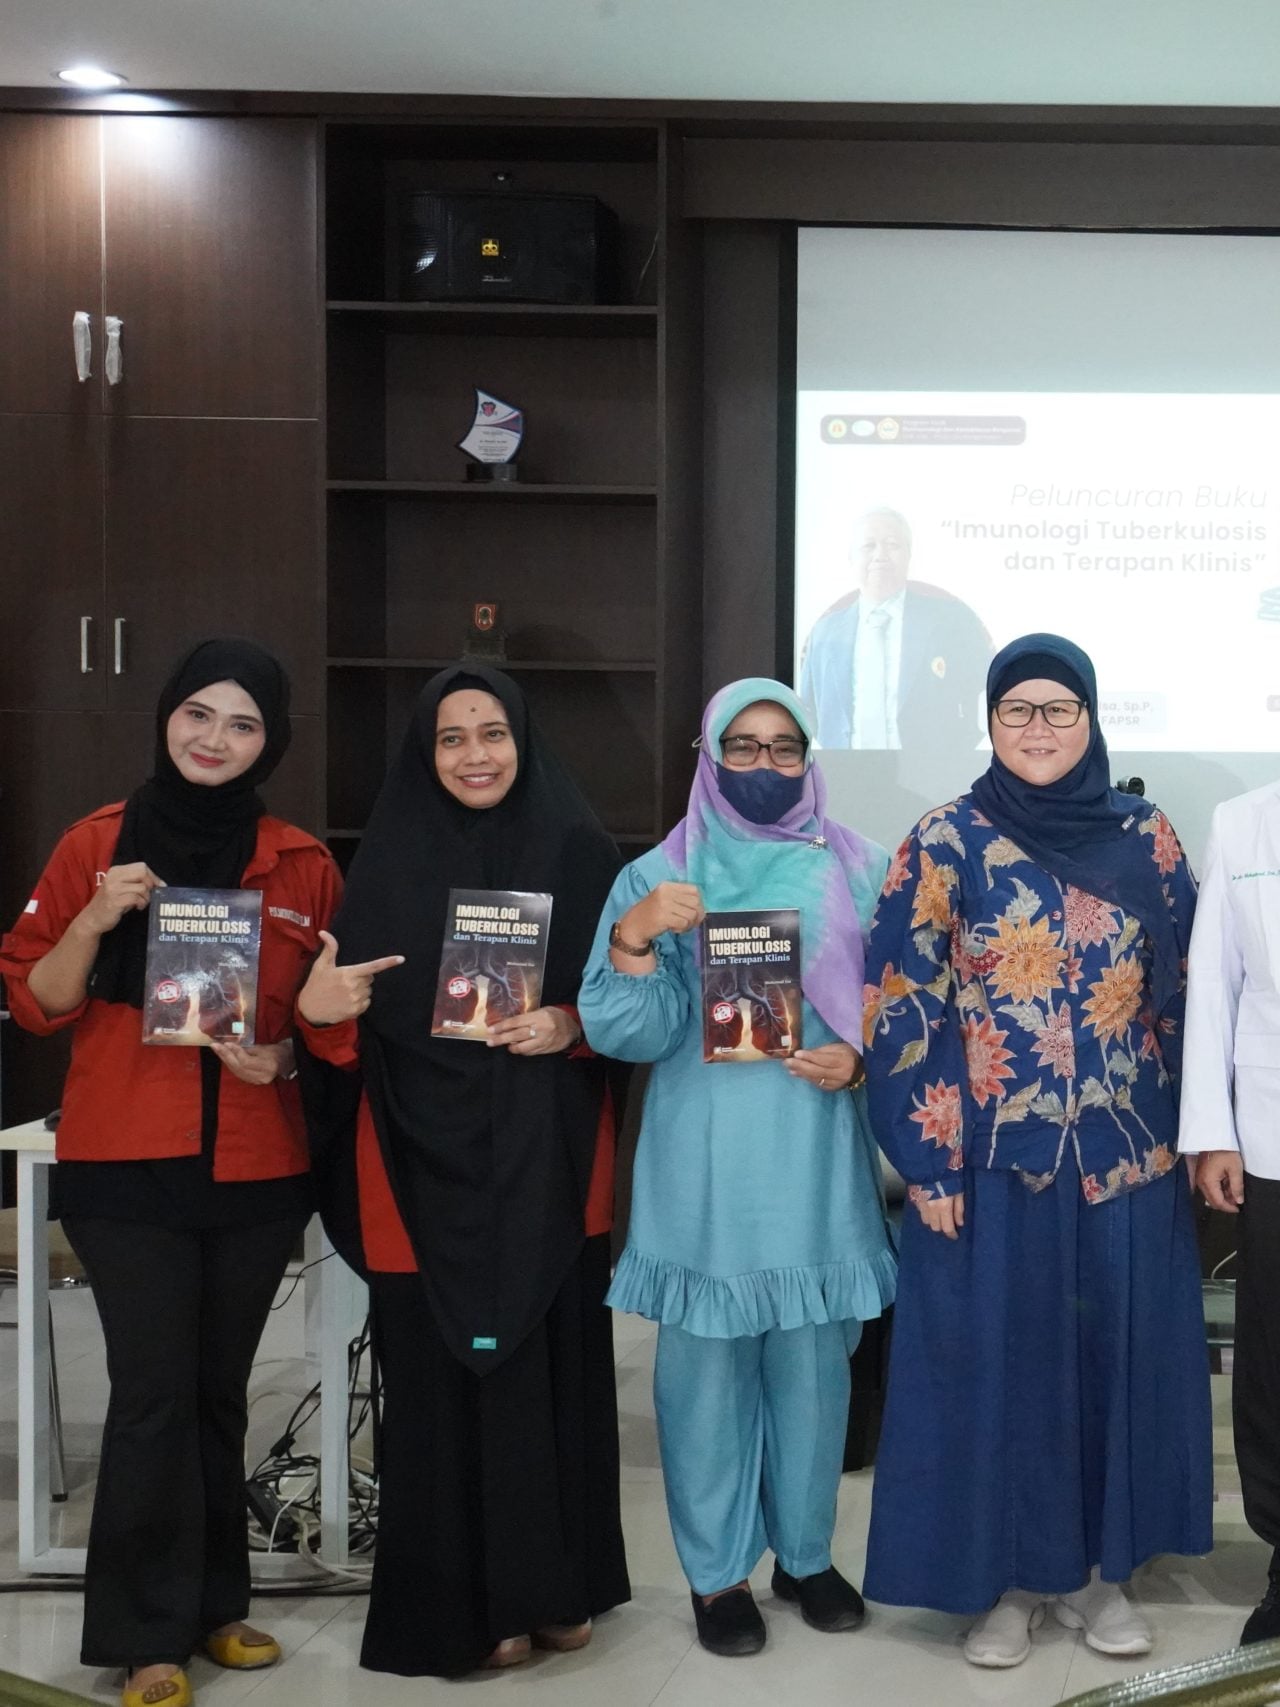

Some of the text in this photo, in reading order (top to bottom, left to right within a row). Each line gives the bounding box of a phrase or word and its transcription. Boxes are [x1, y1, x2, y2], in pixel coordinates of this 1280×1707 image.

[1010, 484, 1267, 508] Peluncuran Buku
[1096, 520, 1267, 542] Tuberkulosis
[1004, 551, 1055, 571] dan
[1062, 552, 1173, 578] Terapan
[160, 903, 229, 918] IMUNOLOGI
[456, 904, 520, 920] IMUNOLOGI
[160, 919, 252, 934] TUBERKULOSIS
[455, 919, 540, 935] TUBERKULOSIS
[709, 926, 770, 942] IMUNOLOGI
[159, 933, 249, 945] dan Terapan Klinis
[453, 932, 537, 945] dan Terapan Klinis
[710, 940, 792, 956] TUBERKULOSIS
[710, 954, 791, 966] dan Terapan Klinis
